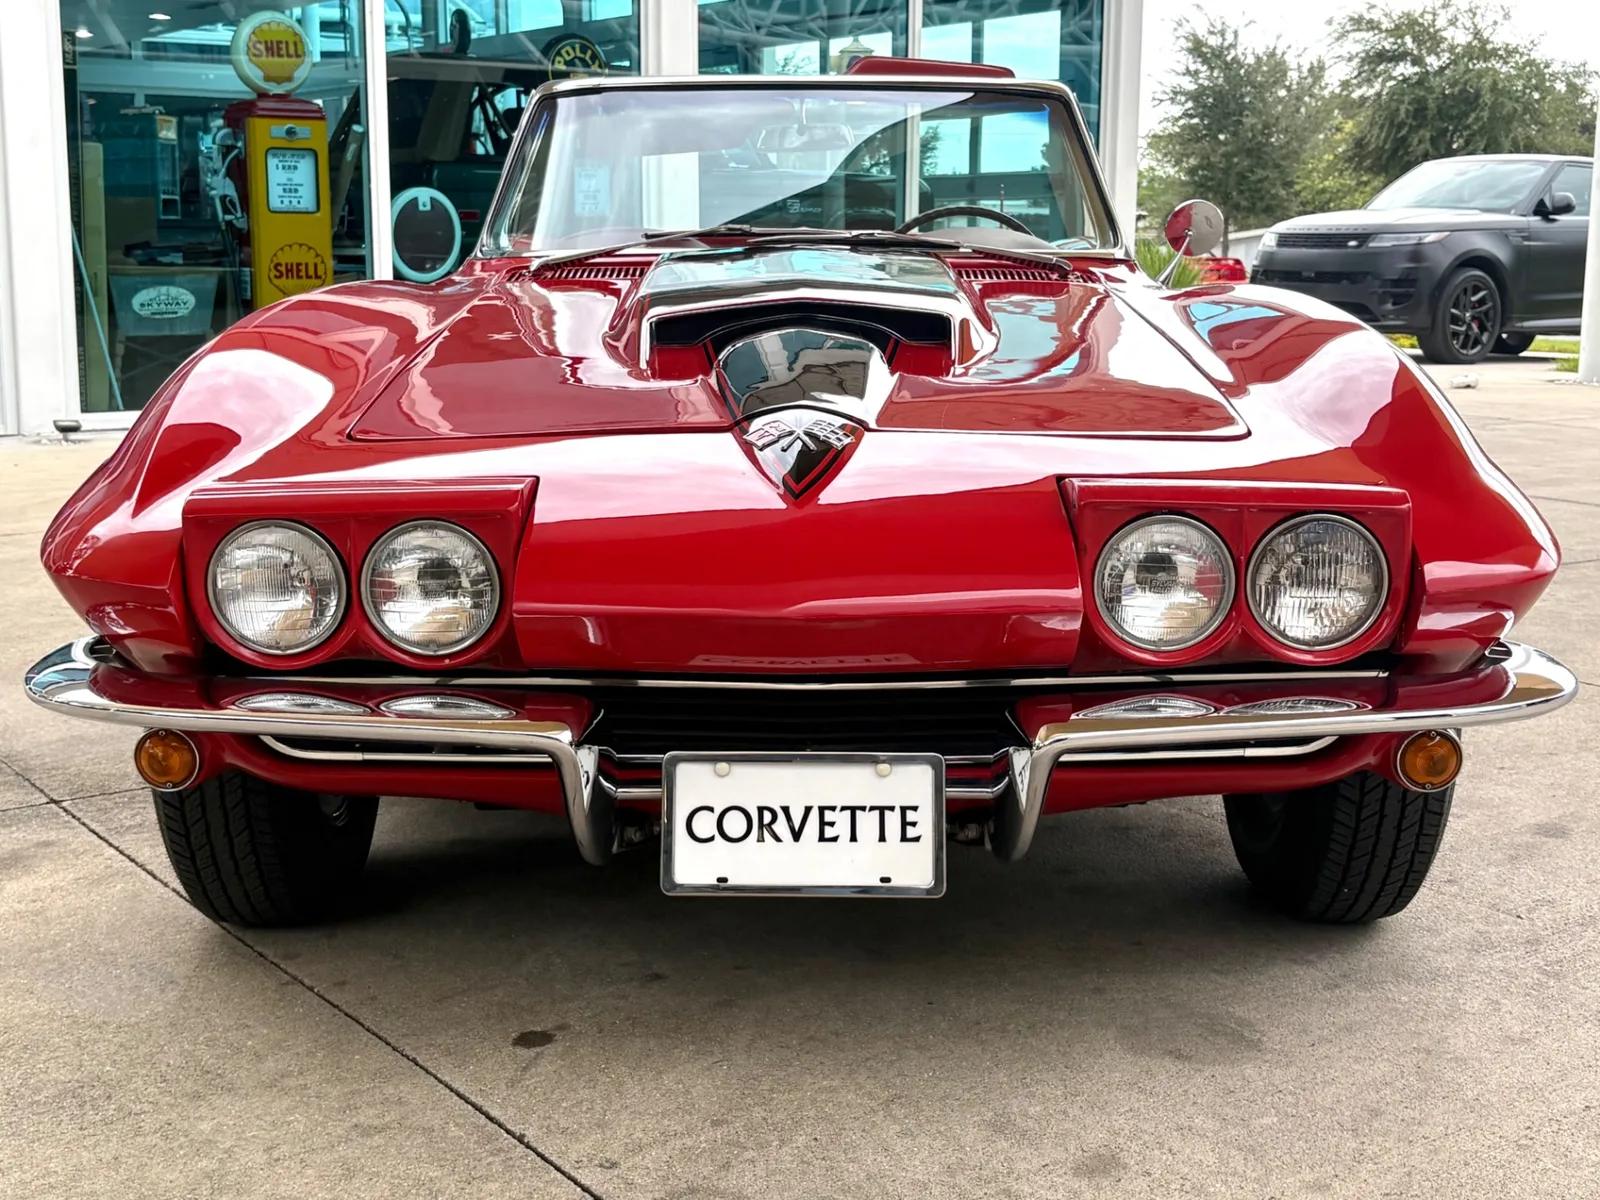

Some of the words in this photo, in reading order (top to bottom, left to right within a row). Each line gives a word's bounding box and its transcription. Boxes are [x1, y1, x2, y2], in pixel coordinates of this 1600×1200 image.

[252, 40, 303, 58] SHELL
[553, 43, 602, 72] POLLY
[273, 262, 322, 280] SHELL
[685, 805, 922, 844] CORVETTE
